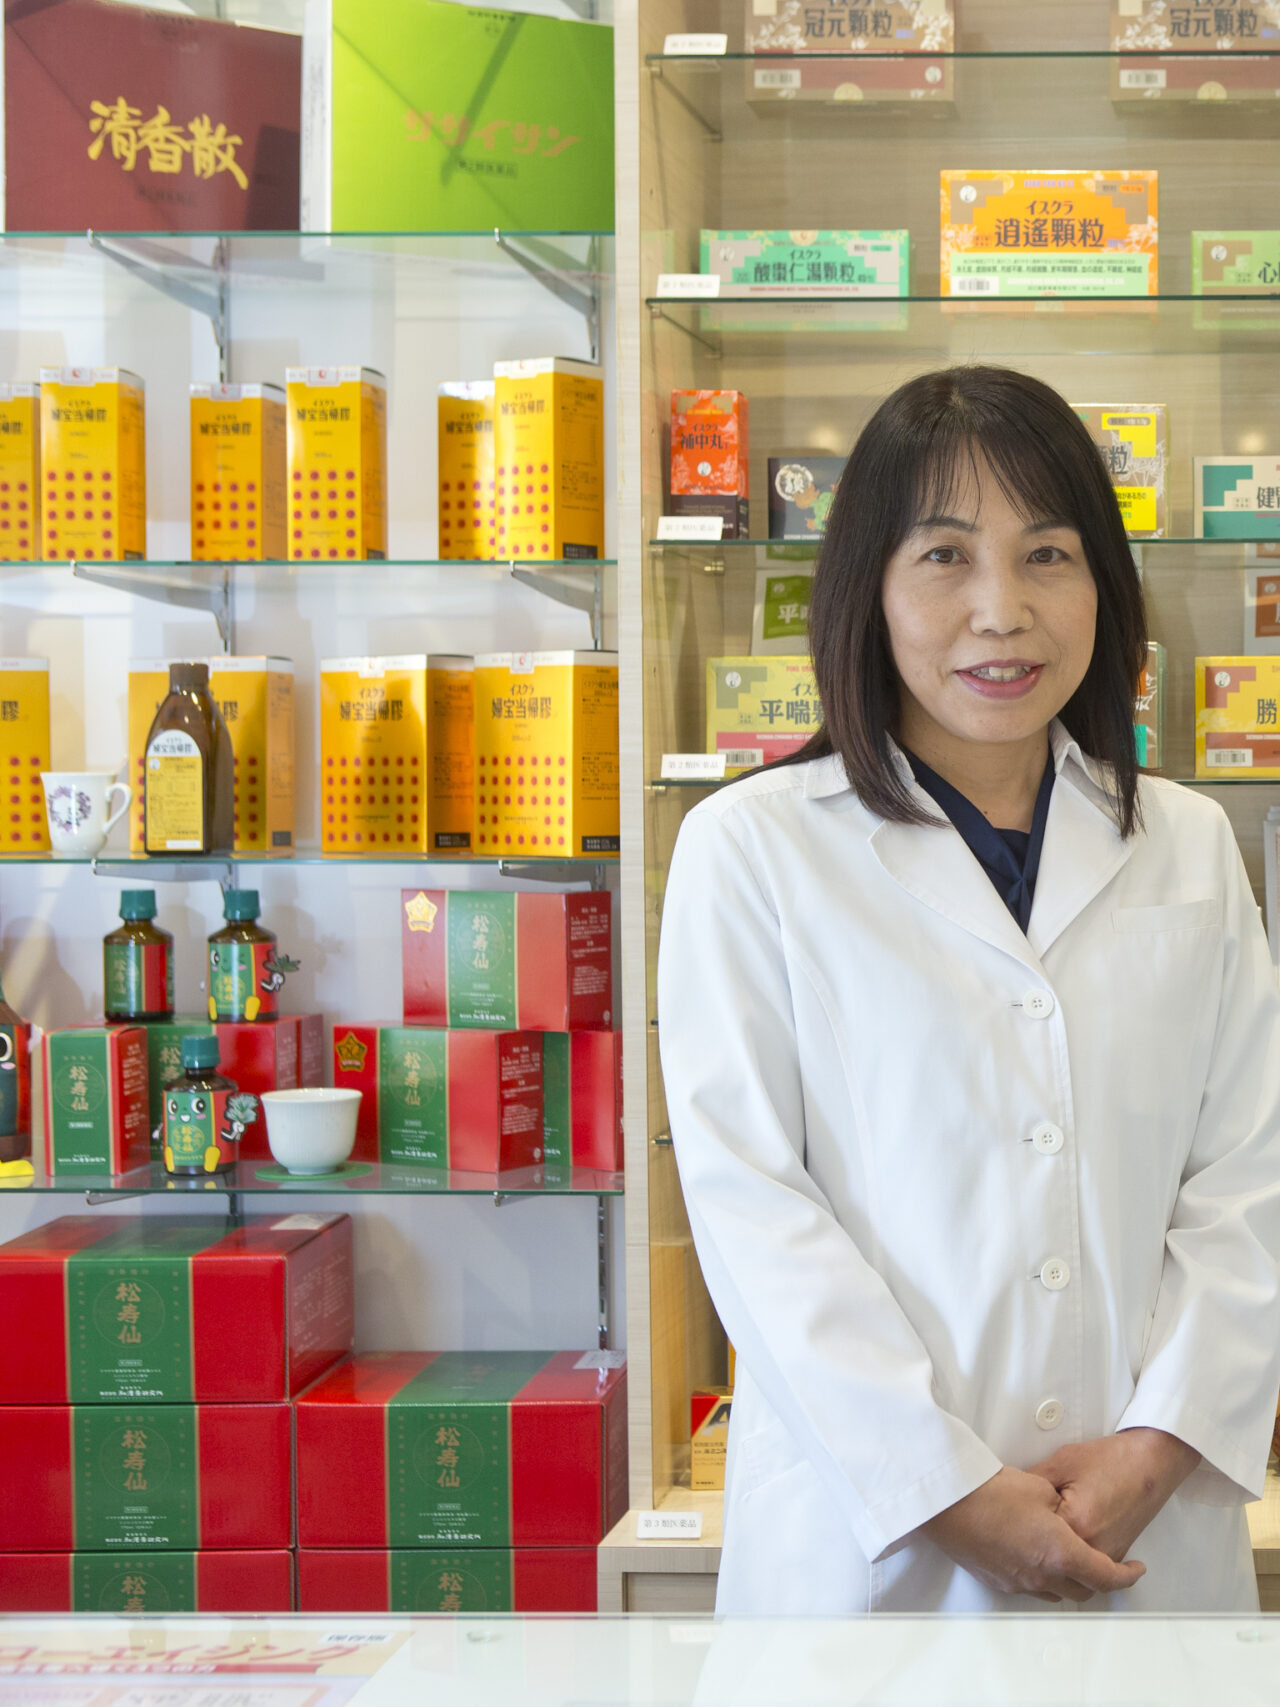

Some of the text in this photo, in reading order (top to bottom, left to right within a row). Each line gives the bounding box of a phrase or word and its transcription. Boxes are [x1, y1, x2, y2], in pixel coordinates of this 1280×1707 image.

[803, 8, 892, 38] 冠元顆粒
[1169, 8, 1258, 38] 冠元顆粒
[87, 96, 249, 190] 清香散
[1026, 200, 1075, 215] イスクラ
[790, 250, 822, 261] イスクラ
[692, 423, 718, 432] イスクラ
[359, 687, 385, 700] イスクラ
[509, 684, 534, 696] イスクラ
[339, 700, 403, 722] 婦宝当帰膠
[491, 697, 552, 720] 婦宝当帰膠
[471, 914, 489, 970] 松寿仙
[159, 1047, 181, 1082] 松寿
[403, 1051, 421, 1106] 松寿仙
[69, 1065, 89, 1111] 松寿仙
[115, 1283, 142, 1344] 松寿仙
[121, 1430, 148, 1491] 松寿仙
[435, 1426, 461, 1488] 松寿仙
